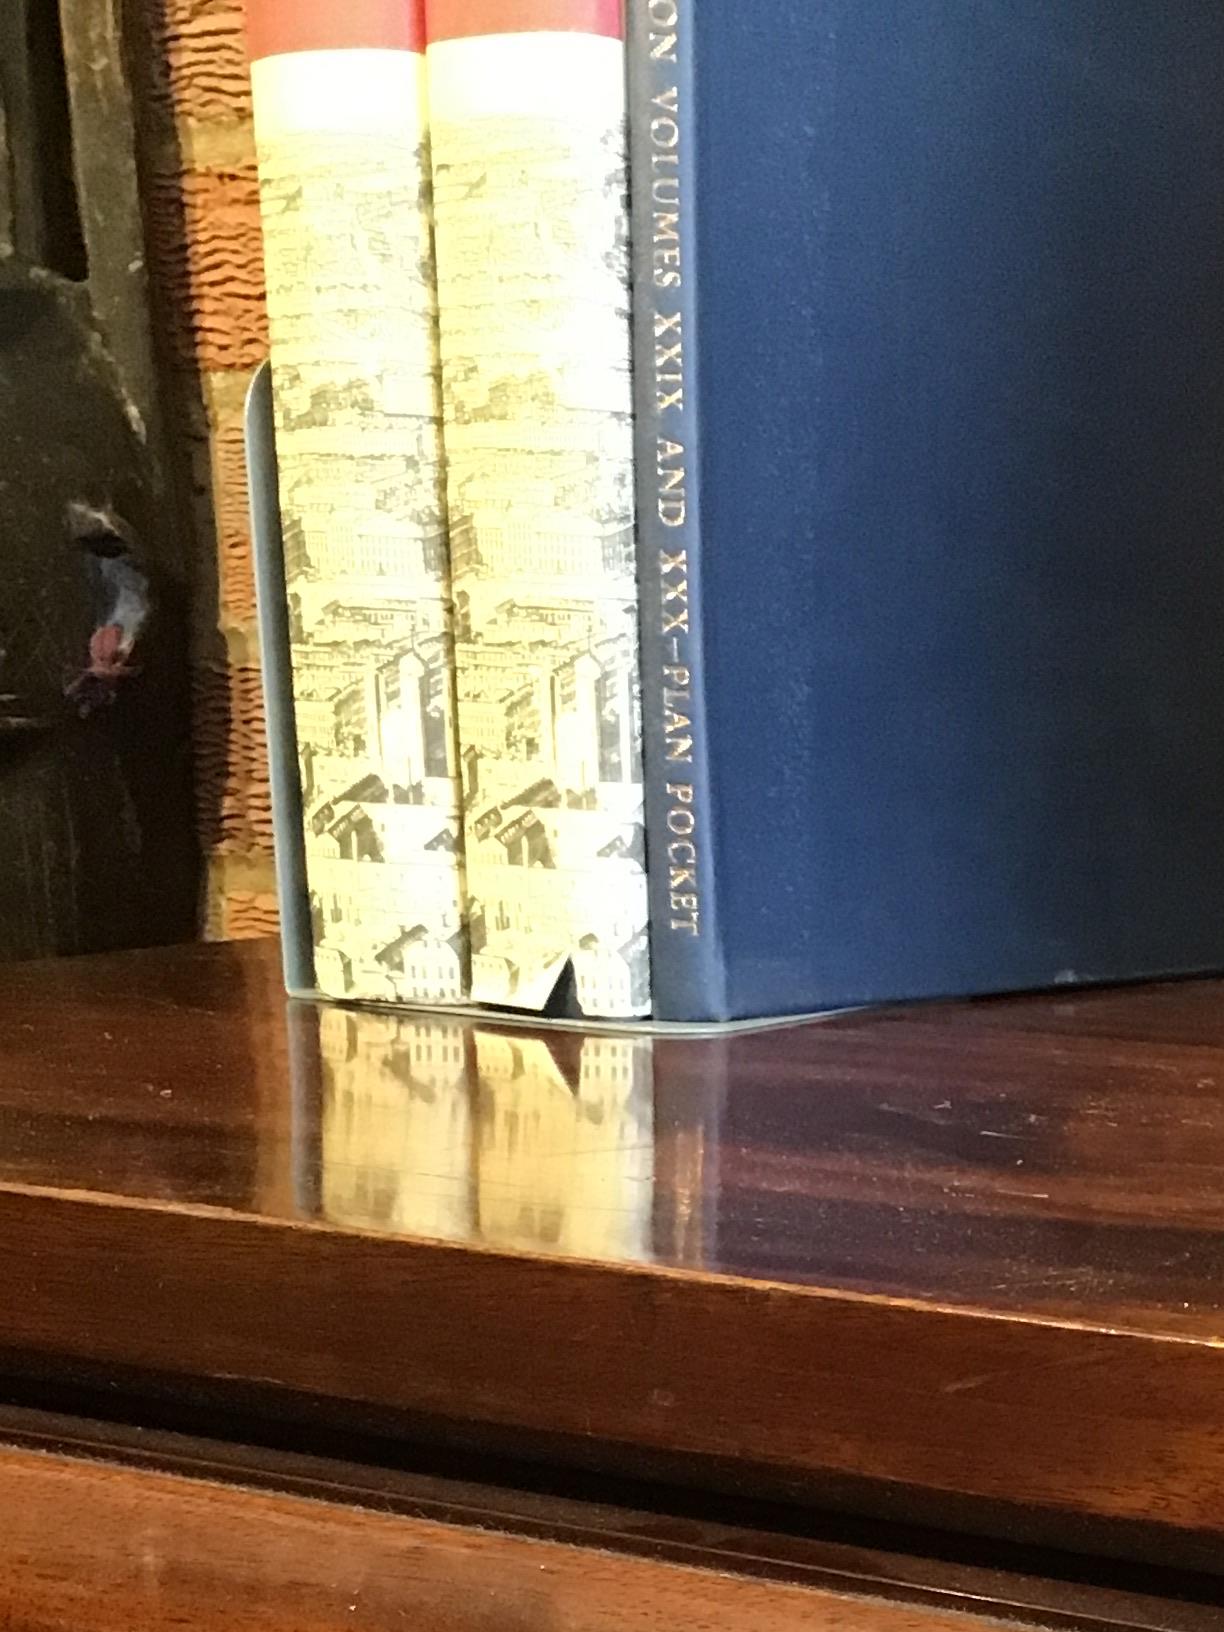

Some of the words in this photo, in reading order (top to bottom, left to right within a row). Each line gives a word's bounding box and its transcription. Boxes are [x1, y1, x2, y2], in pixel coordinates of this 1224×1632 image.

[648, 0, 678, 63] ON
[650, 86, 681, 289] VOLUMES
[653, 311, 684, 412] XXIX
[657, 437, 686, 527] AND
[666, 782, 699, 937] POCKET
